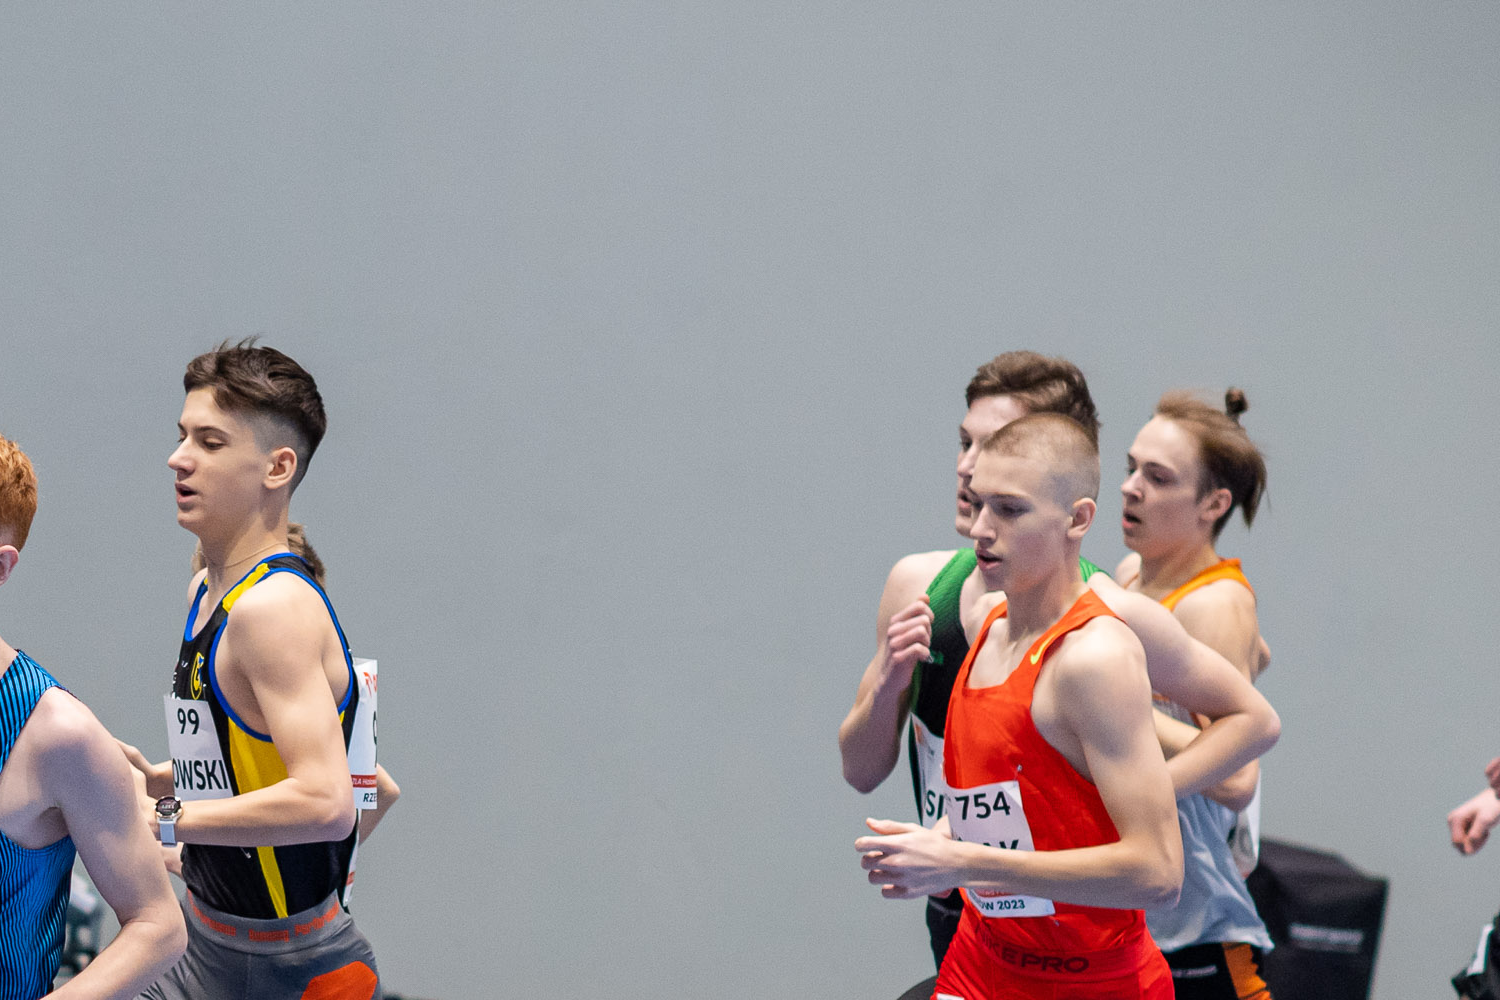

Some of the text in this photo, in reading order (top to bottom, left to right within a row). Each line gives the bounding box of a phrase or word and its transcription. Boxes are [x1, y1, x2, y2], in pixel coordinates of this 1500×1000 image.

[177, 707, 201, 735] 99
[954, 791, 1011, 821] 754
[997, 900, 1026, 911] 2023
[1020, 952, 1090, 973] PRO
